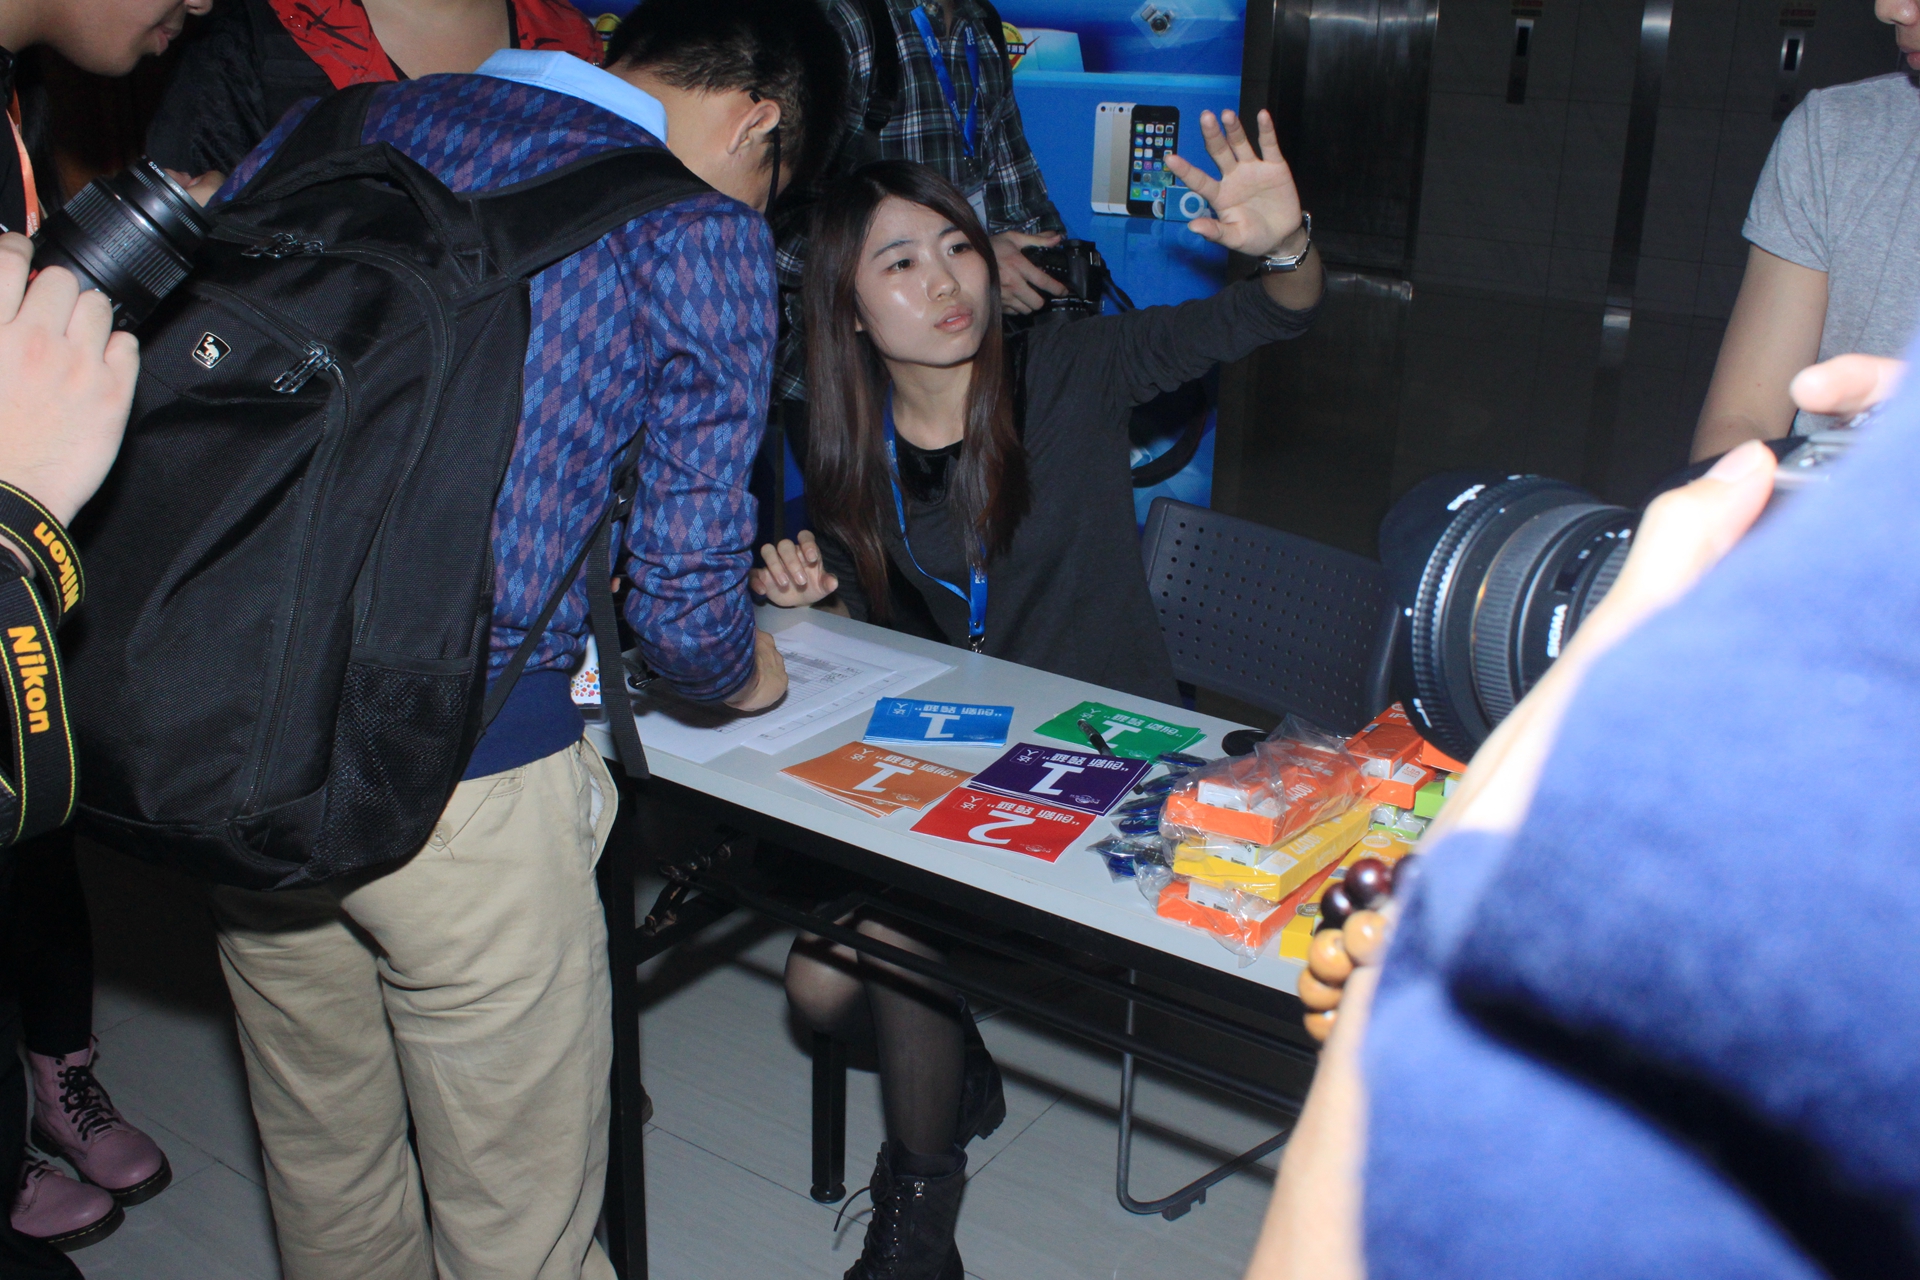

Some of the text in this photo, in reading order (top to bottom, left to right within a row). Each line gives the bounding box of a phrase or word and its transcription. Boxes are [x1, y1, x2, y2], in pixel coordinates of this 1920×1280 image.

[33, 521, 81, 613] Nikon
[1547, 604, 1568, 658] SIGMA
[7, 625, 50, 734] Nikon
[919, 712, 961, 739] 1
[1087, 720, 1142, 749] 1
[852, 761, 915, 793] 1
[1028, 761, 1085, 796] 1
[967, 810, 1037, 845] 2
